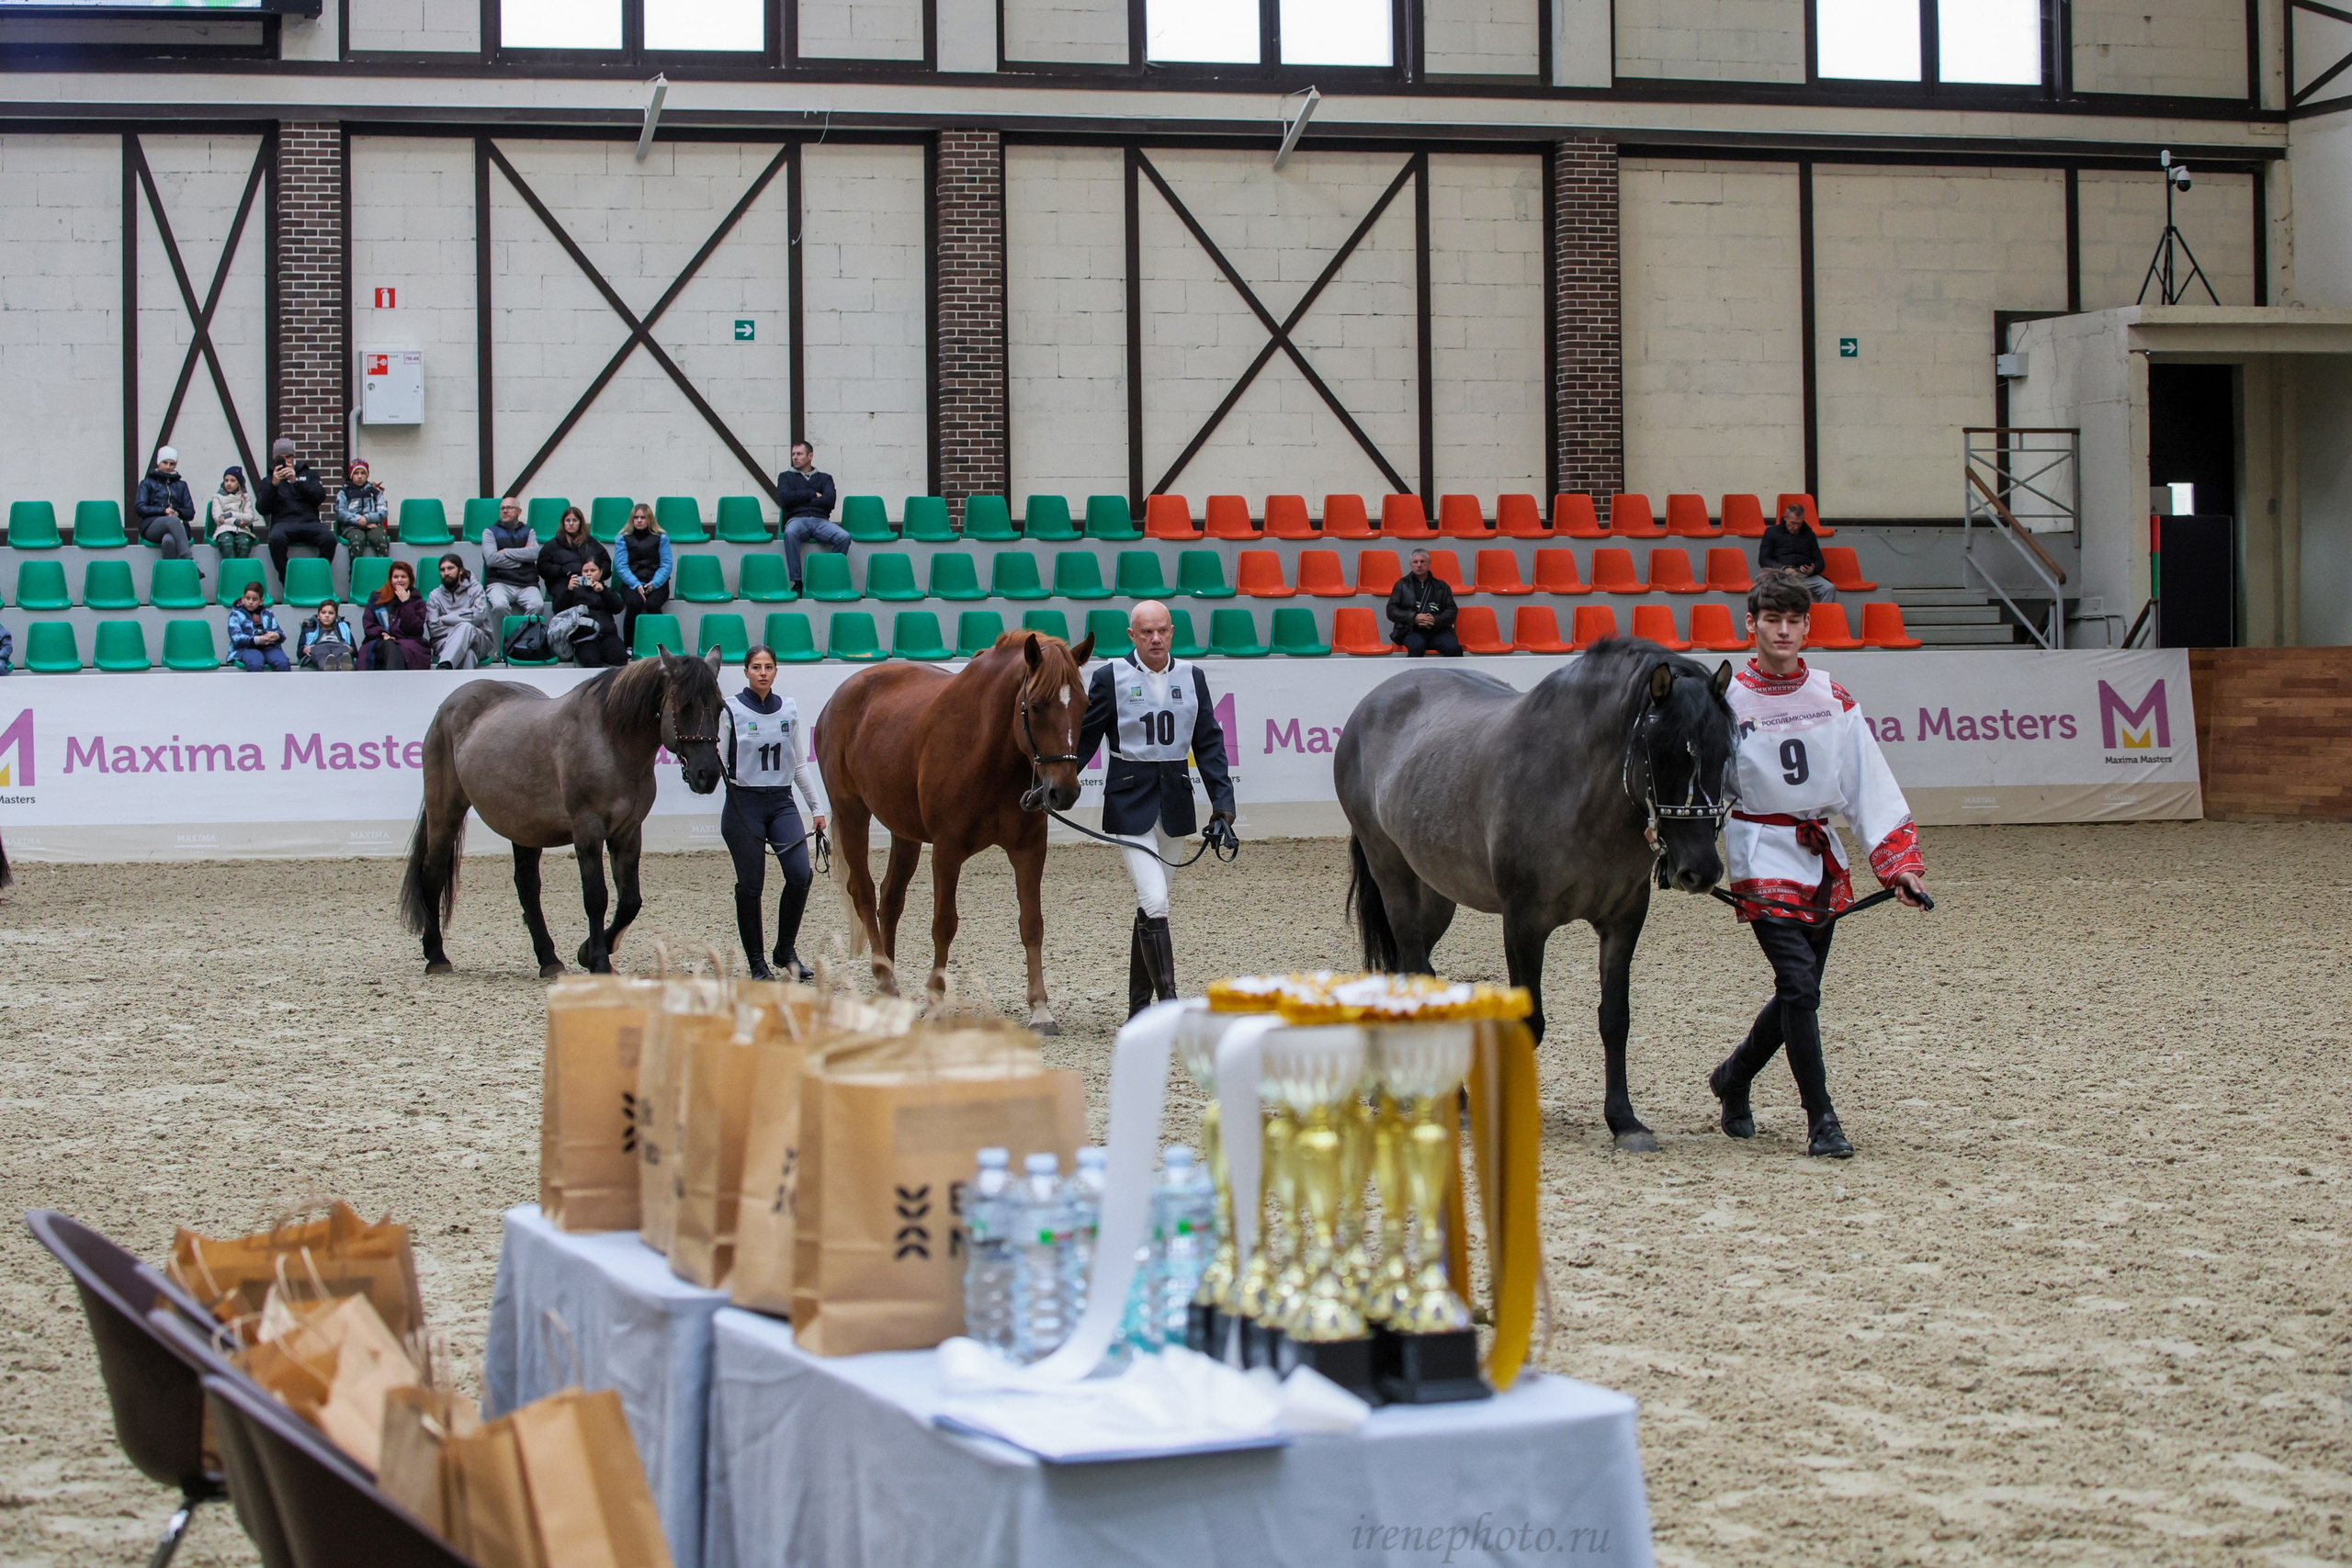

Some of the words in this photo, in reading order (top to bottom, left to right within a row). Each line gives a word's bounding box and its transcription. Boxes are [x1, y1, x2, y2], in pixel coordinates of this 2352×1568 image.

[1139, 710, 1174, 745] 10
[1761, 710, 1832, 727] РОСПЛЕМКОНЗАВОД
[1917, 707, 2077, 741] Masters
[63, 736, 266, 773] Maxima
[280, 733, 424, 771] Maste
[758, 742, 781, 771] 11
[1779, 739, 1809, 785] 9
[2140, 755, 2172, 763] Masters
[1080, 778, 1103, 786] sters
[176, 834, 216, 842] MAXIMA
[692, 825, 721, 833] MAXI
